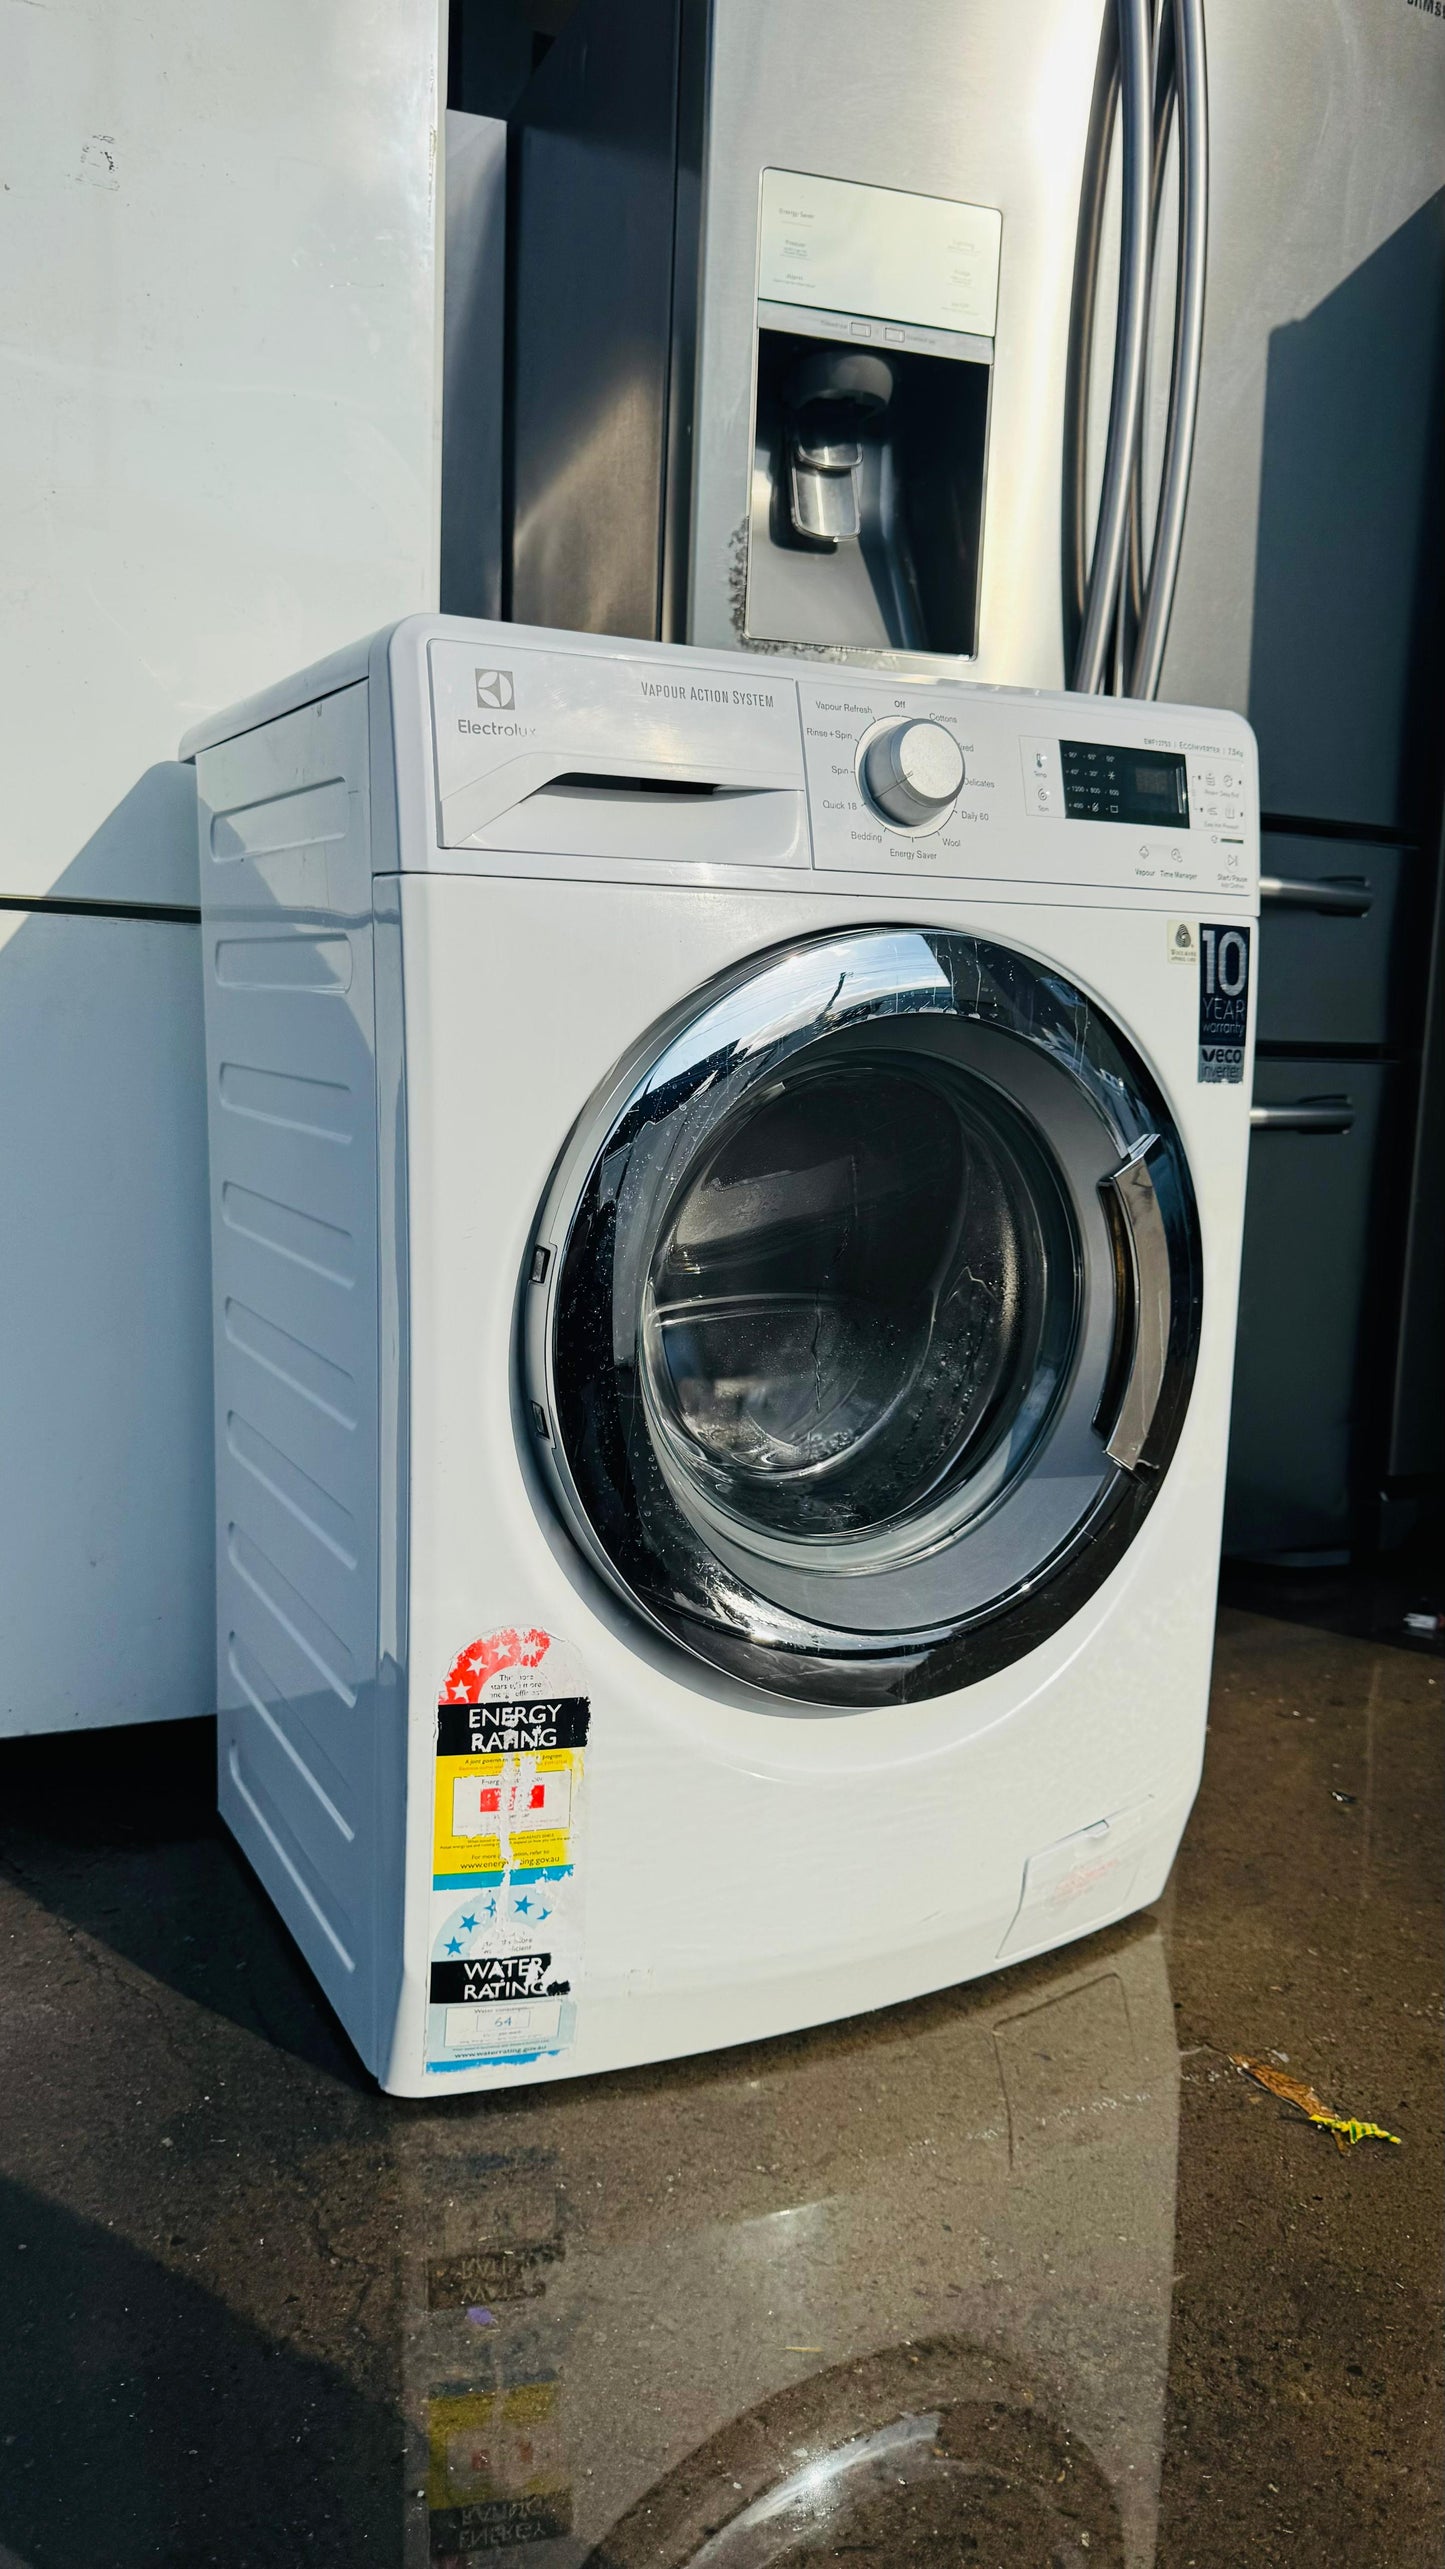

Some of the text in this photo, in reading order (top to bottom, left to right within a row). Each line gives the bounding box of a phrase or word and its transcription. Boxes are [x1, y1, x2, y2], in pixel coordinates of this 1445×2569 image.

[641, 682, 774, 708] VAPOUR ACTION SYSTEM
[815, 701, 873, 714] Vapour Refresh
[894, 700, 906, 709] Off
[929, 712, 958, 724] Cottons
[458, 719, 536, 737] Electrolux
[831, 766, 849, 776] Spin
[823, 800, 857, 811] Quick 18
[961, 810, 989, 822] Daily 60
[851, 831, 883, 843] Bedding
[942, 837, 961, 847] Wool
[890, 848, 937, 860] Energy Saver
[1202, 930, 1247, 997] 10
[1203, 997, 1246, 1020] YEAR
[1203, 1021, 1246, 1038] warranty
[1202, 1065, 1241, 1079] inverter
[469, 1704, 562, 1729] ENERGY
[471, 1729, 557, 1753] RATING
[464, 1957, 544, 1980] WATER
[495, 2016, 512, 2028] 64
